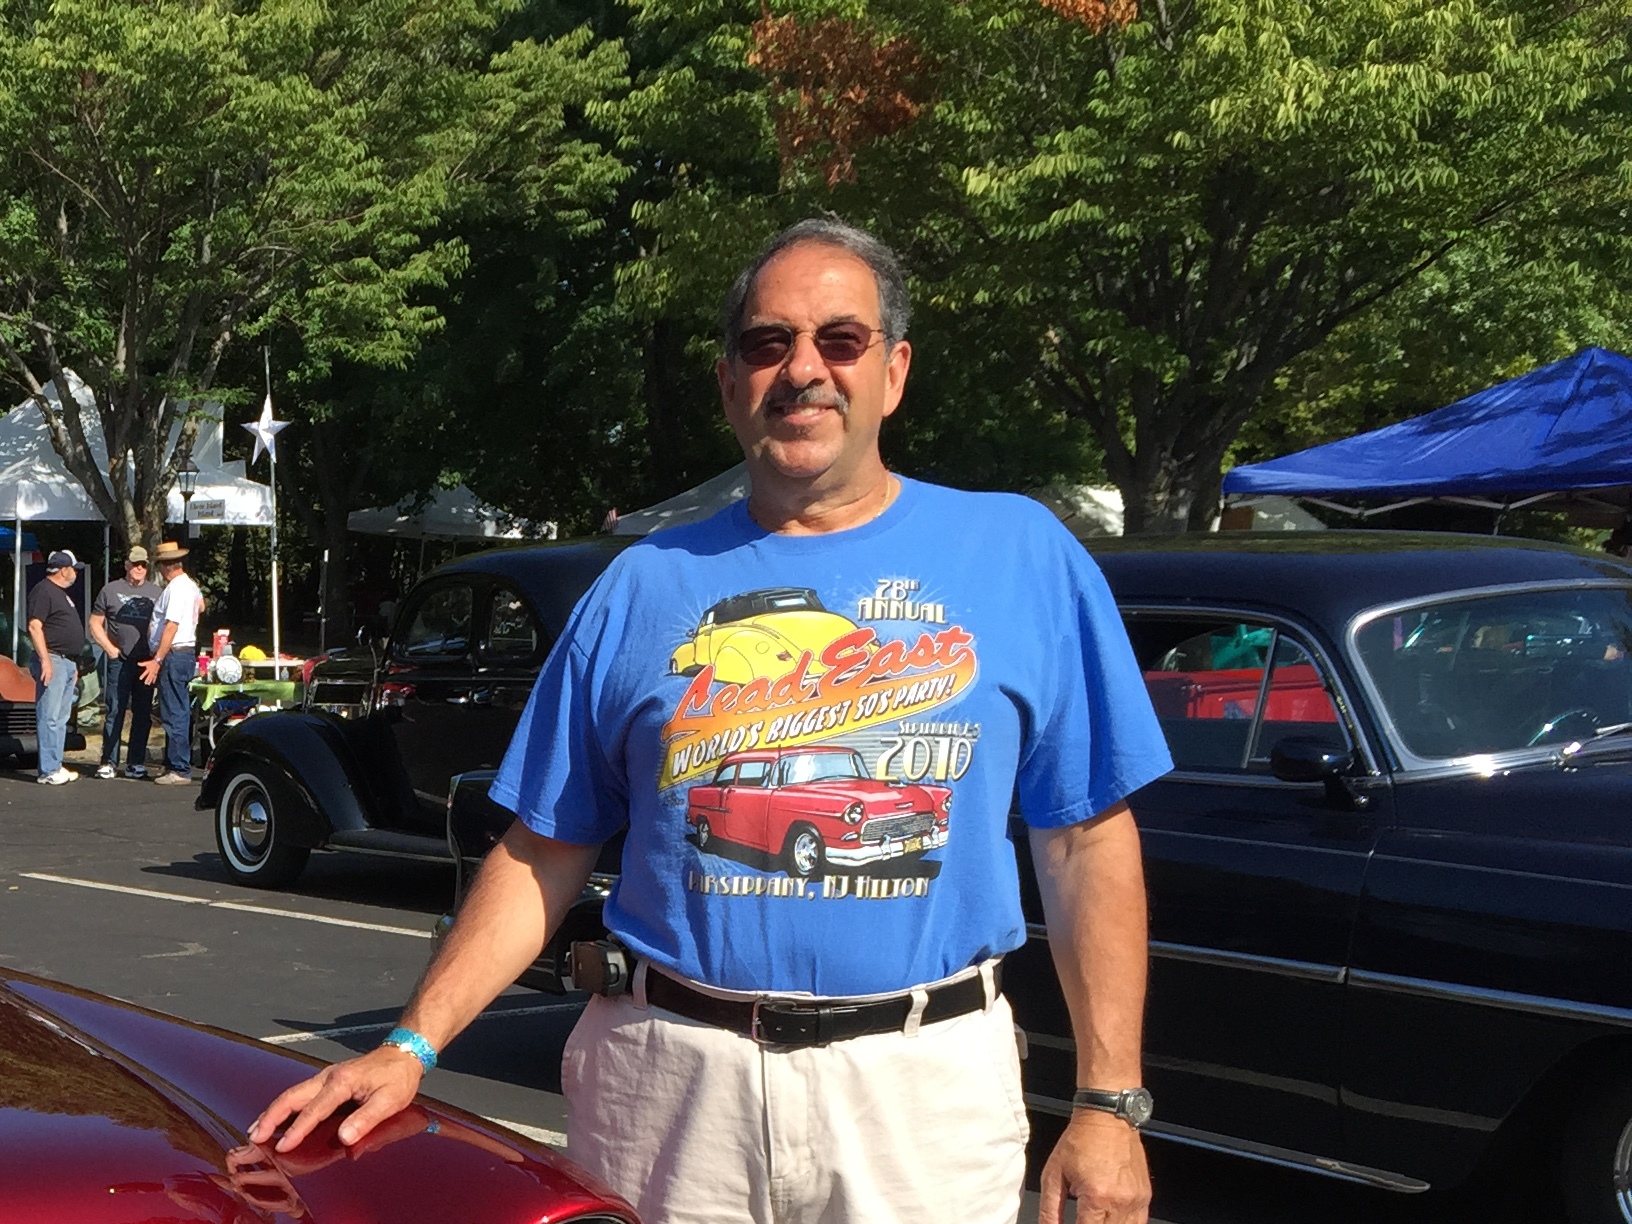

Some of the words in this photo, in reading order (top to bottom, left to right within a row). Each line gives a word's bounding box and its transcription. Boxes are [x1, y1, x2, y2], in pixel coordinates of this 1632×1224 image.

[858, 598, 948, 624] ANNUAL
[662, 649, 816, 741] Lead
[819, 626, 974, 694] East
[672, 720, 764, 778] WORLD'S
[765, 699, 852, 744] BIGGEST
[853, 687, 894, 721] 50'S
[892, 673, 957, 710] PARTY!
[876, 737, 974, 782] 2010
[822, 875, 851, 899] NJ
[855, 875, 929, 900] HILTON
